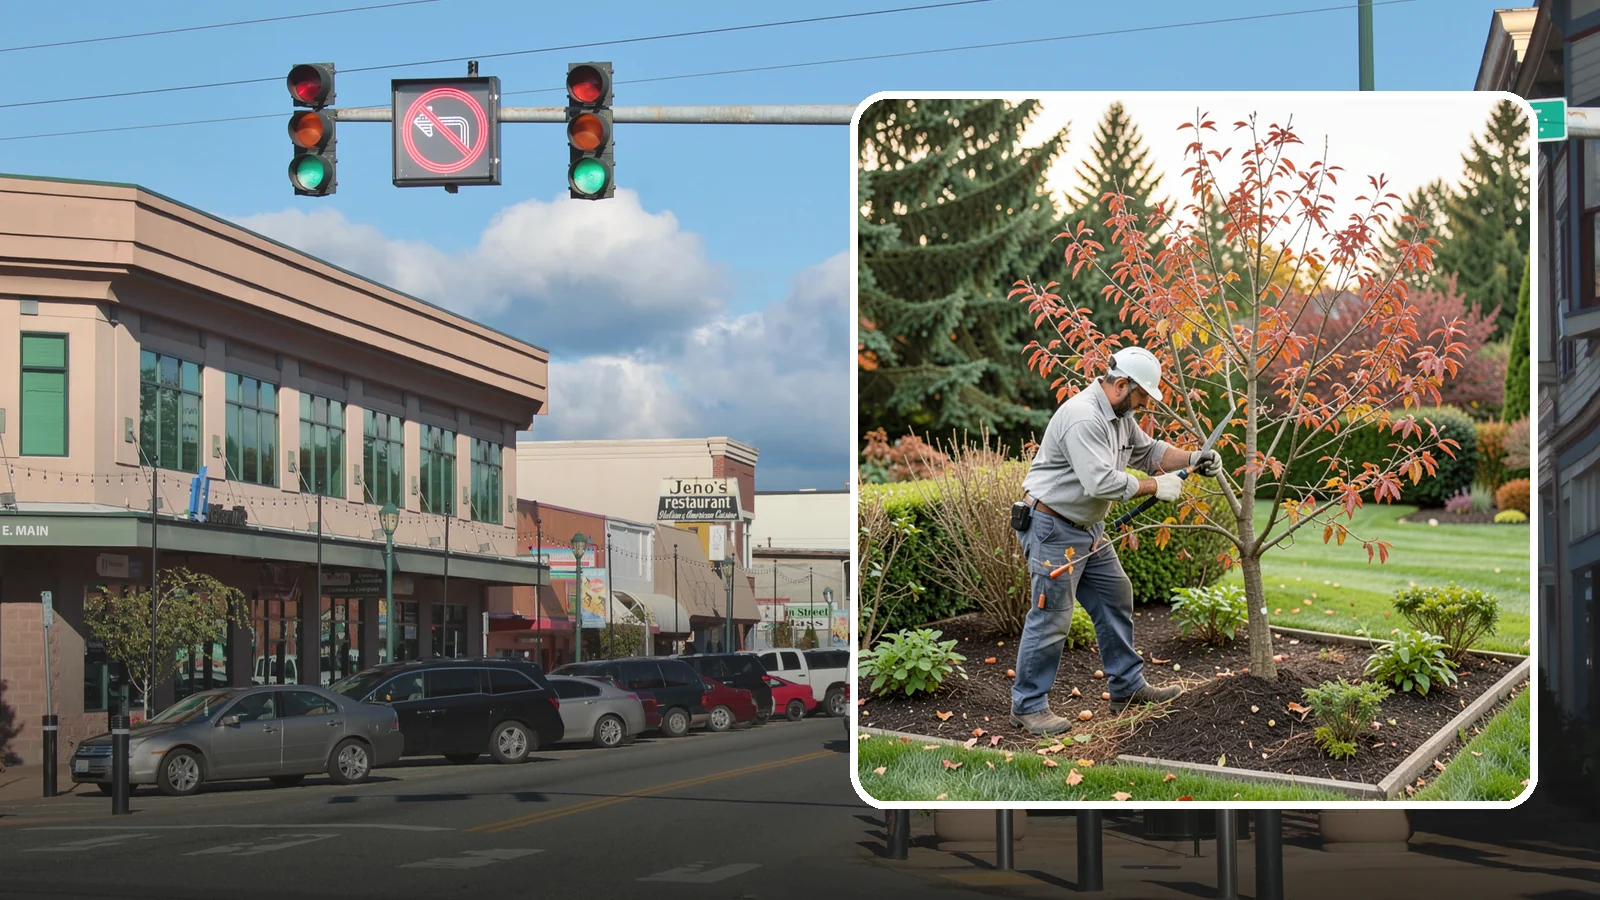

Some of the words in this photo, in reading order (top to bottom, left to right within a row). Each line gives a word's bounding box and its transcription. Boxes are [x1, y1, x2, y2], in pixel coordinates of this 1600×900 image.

[670, 480, 727, 494] Jeno's
[665, 496, 731, 509] restaurant
[658, 510, 681, 519] Italian
[686, 509, 715, 519] American
[715, 509, 738, 519] Cuisine
[2, 525, 13, 536] E.
[15, 525, 49, 536] MAIN
[797, 607, 828, 617] Street
[791, 619, 824, 627] lass
